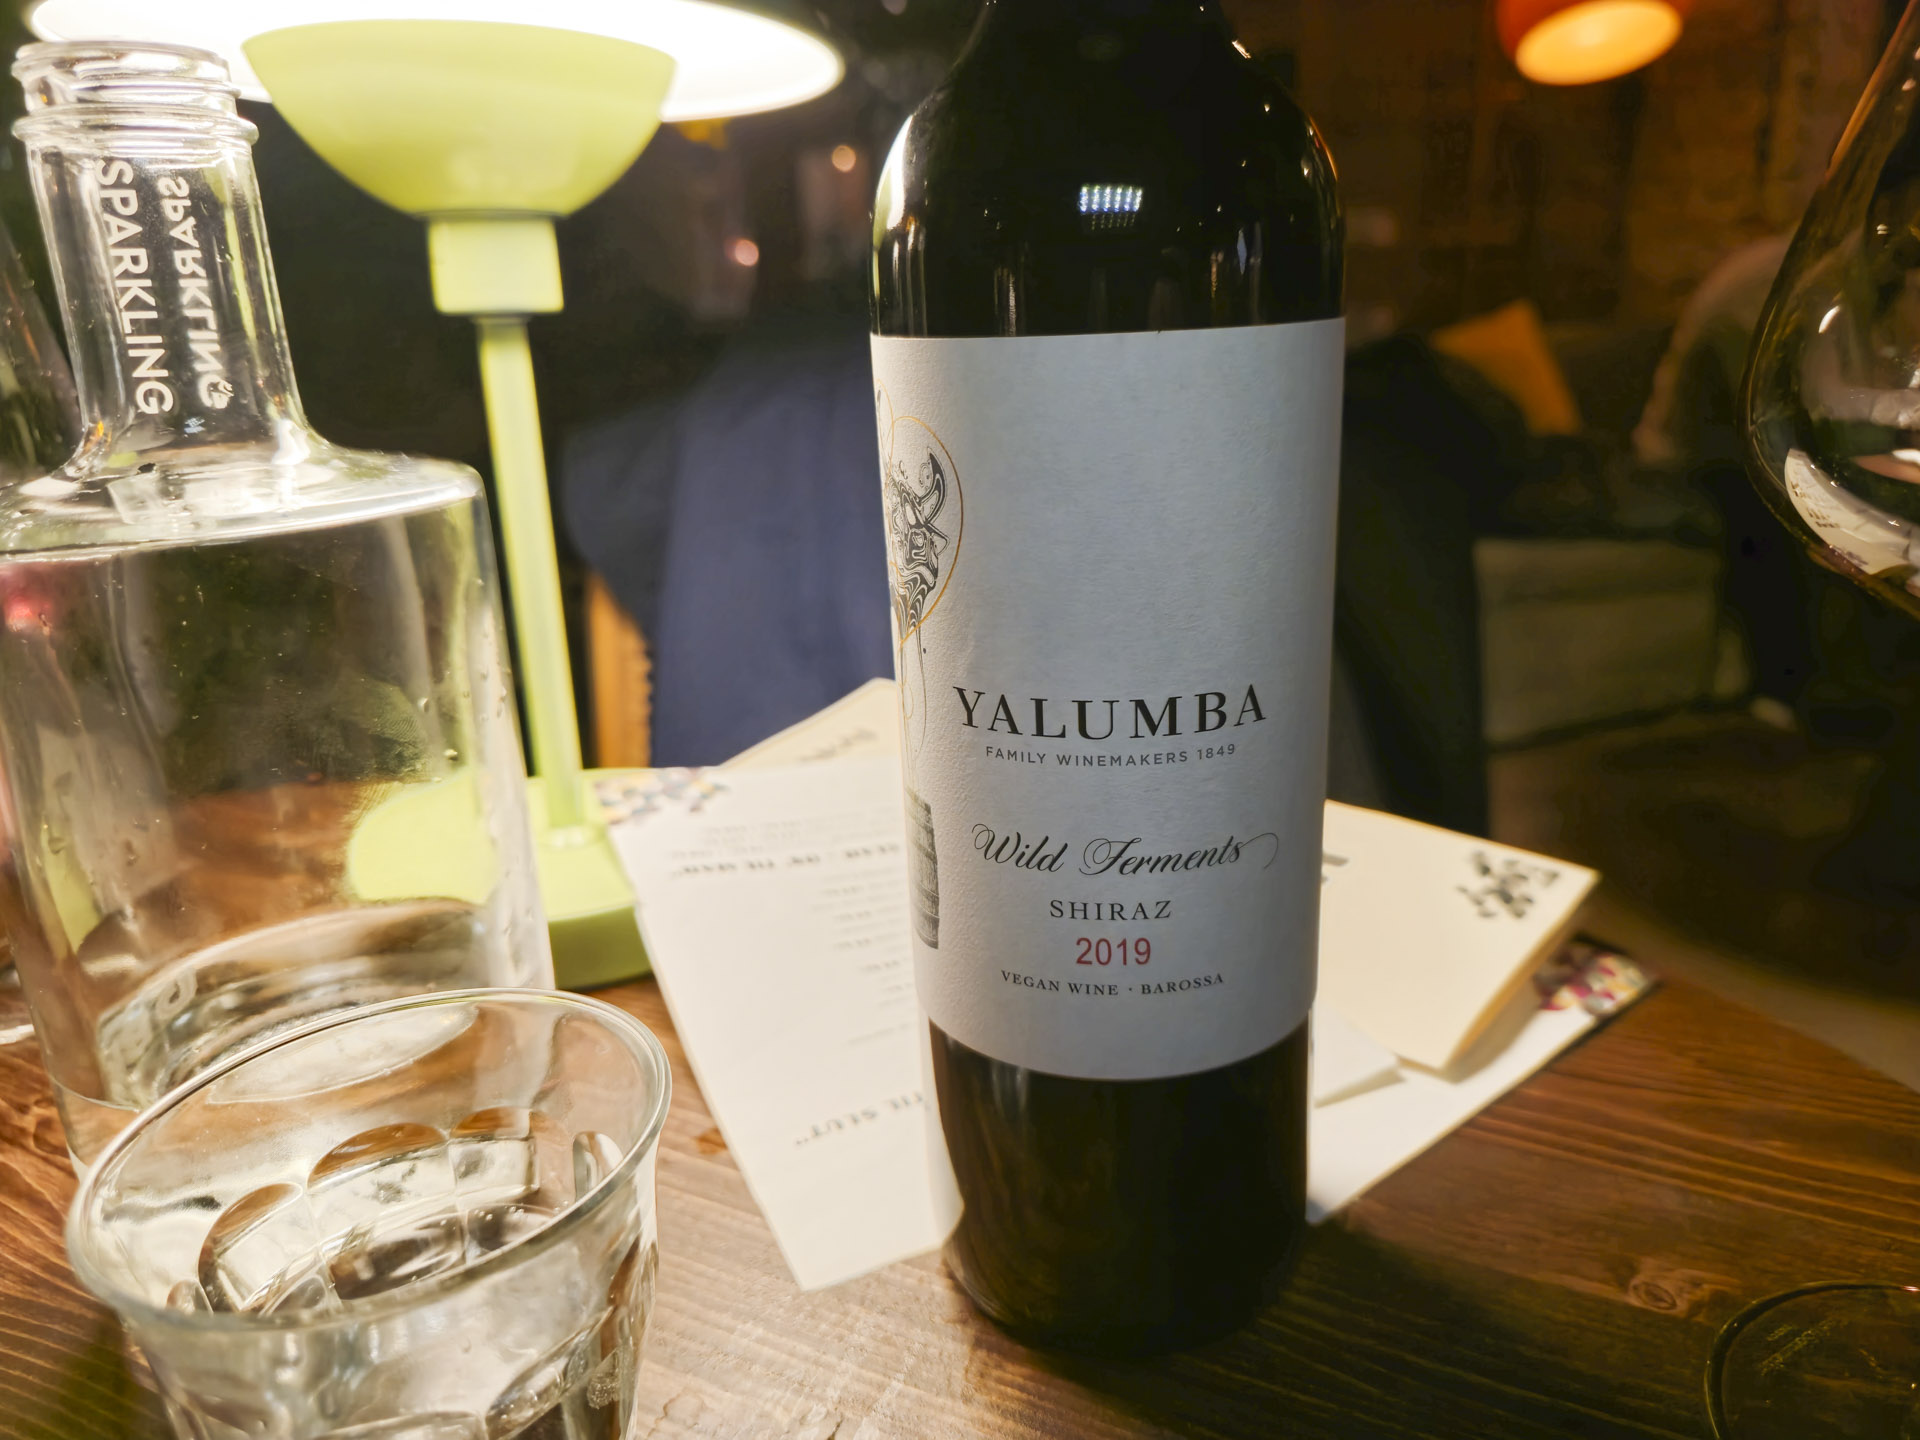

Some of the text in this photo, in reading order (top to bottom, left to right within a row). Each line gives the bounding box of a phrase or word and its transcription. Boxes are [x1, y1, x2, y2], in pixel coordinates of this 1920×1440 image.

[95, 159, 174, 414] SPARKLING
[953, 684, 1266, 740] YALUMBA
[985, 743, 1236, 767] FAMILY WINEMAKERS 1849
[971, 823, 1069, 873] Wild
[1078, 832, 1280, 876] Ferments
[1049, 899, 1172, 921] SHIRAZ
[1075, 937, 1151, 966] 2019
[1001, 969, 1224, 996] VEGAN WINE BAROSSA
